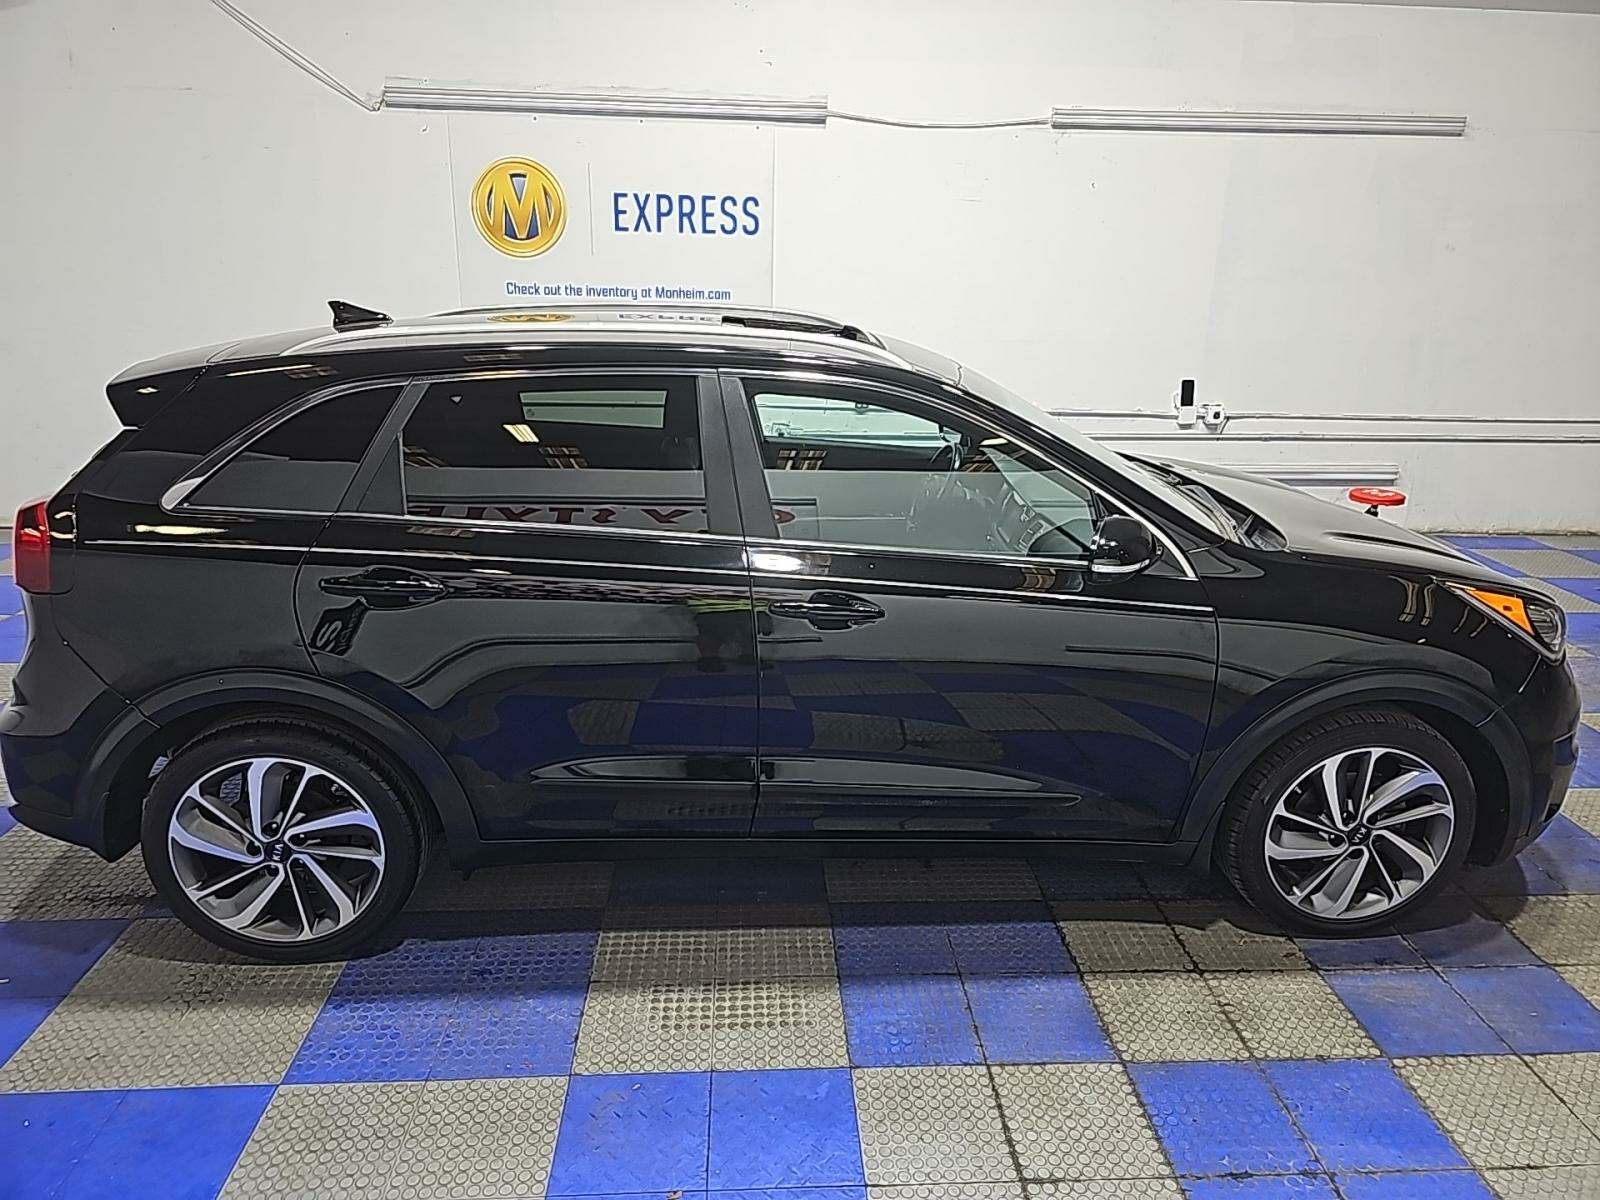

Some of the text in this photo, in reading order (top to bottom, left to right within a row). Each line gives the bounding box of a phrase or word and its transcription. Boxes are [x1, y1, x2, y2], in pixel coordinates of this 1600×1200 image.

[613, 192, 760, 235] EXPRESS
[506, 282, 731, 301] Check out the inventory at Manheim.com
[272, 844, 284, 861] KIA
